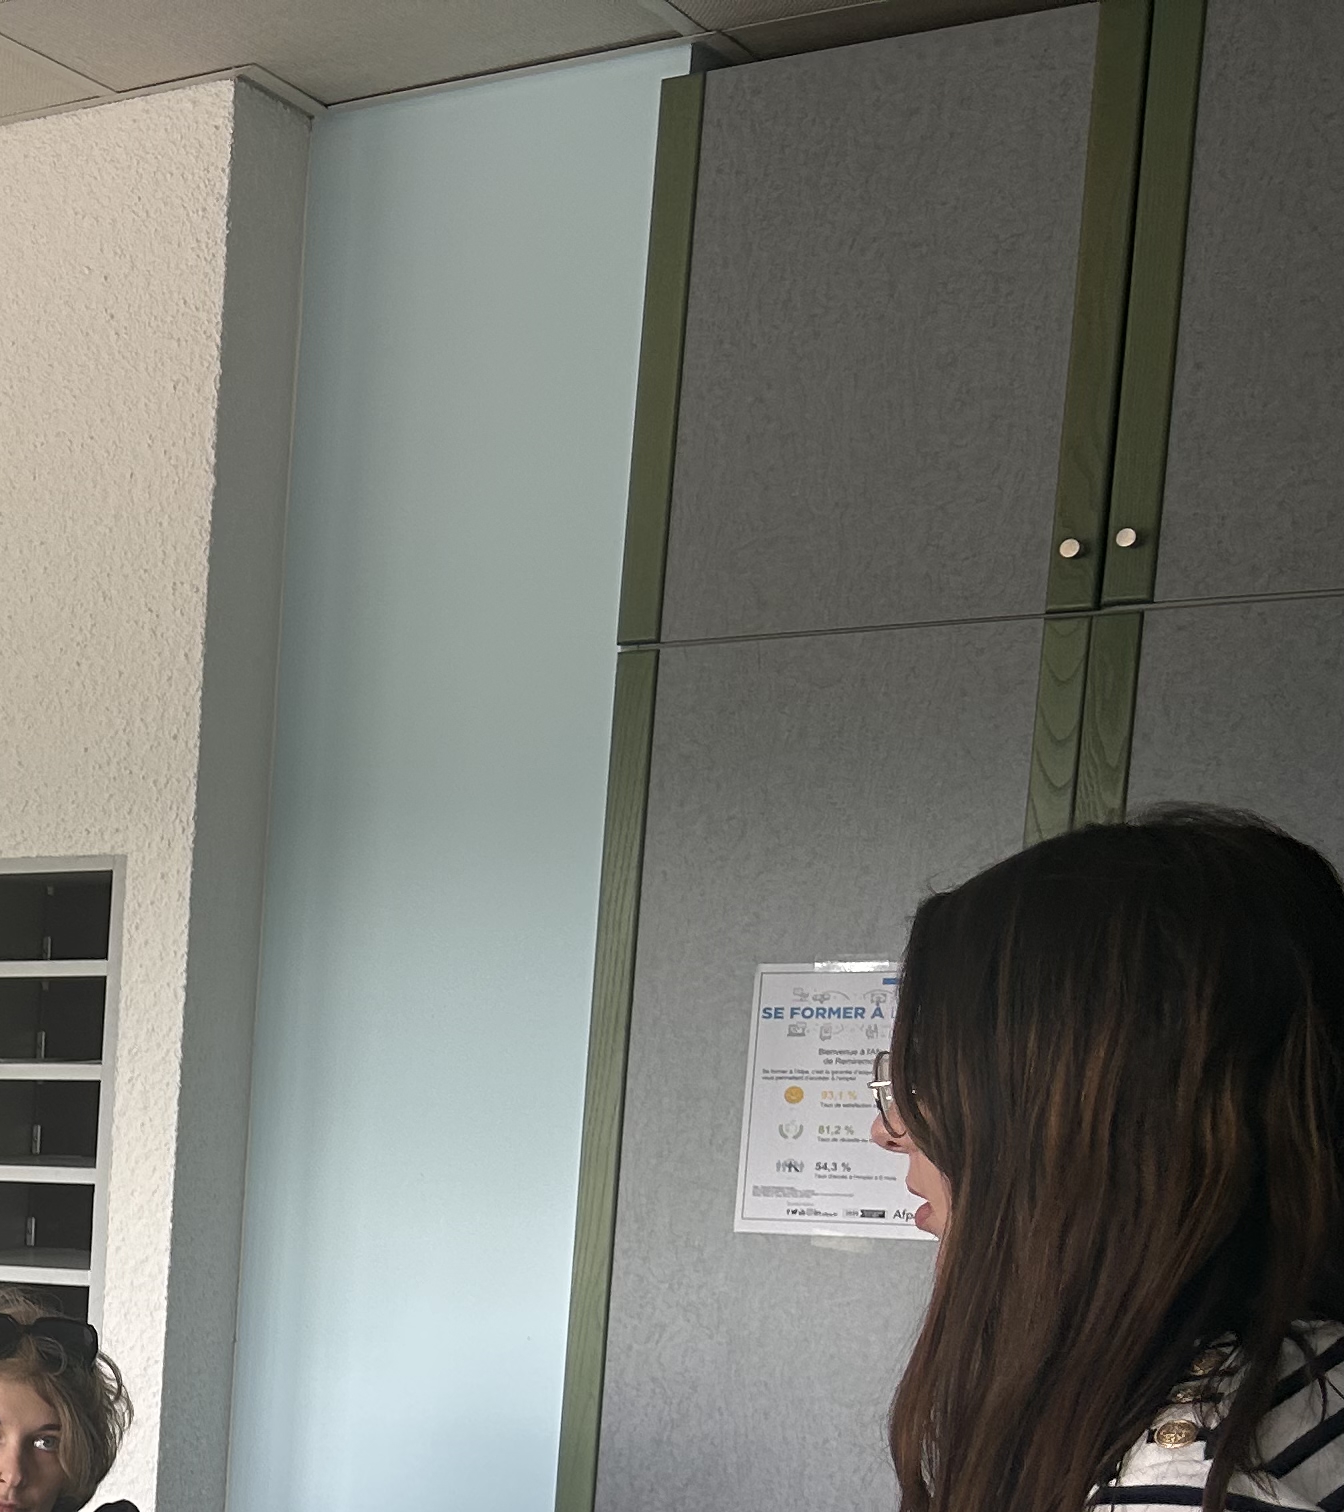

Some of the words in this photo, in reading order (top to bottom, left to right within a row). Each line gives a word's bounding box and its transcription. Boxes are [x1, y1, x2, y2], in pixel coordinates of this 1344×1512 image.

[761, 1006, 784, 1019] SE
[789, 1006, 866, 1020] FORMER
[893, 1209, 916, 1222] Afp
